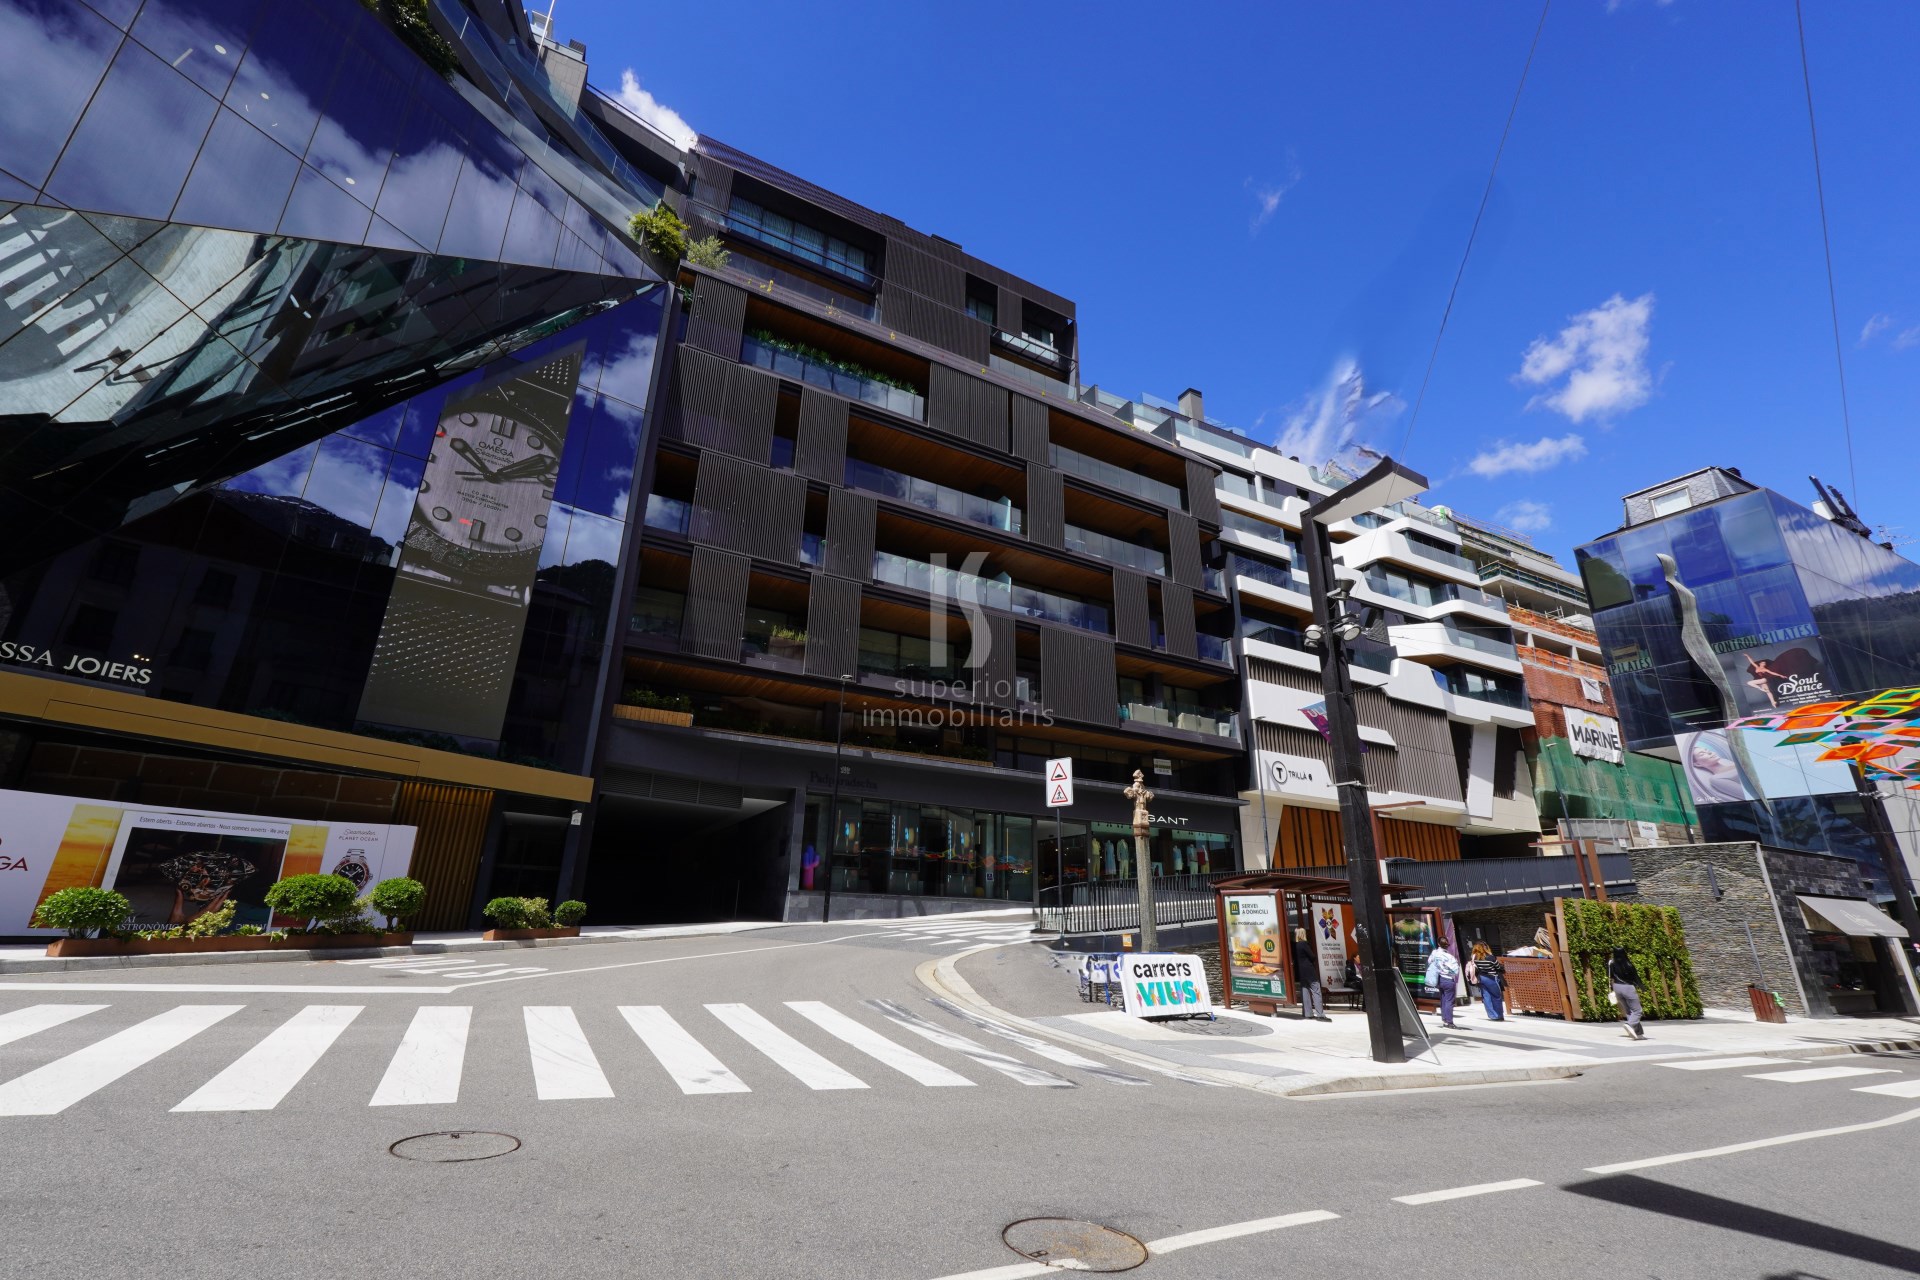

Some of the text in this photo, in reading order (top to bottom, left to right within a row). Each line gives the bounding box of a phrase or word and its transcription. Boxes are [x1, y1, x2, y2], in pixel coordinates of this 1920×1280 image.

[478, 441, 515, 458] OMEGA
[1761, 624, 1812, 645] PILATES
[0, 641, 152, 684] SSA JOIERS
[1610, 657, 1651, 676] PILATES
[1788, 672, 1819, 686] Soul
[1777, 682, 1823, 696] Dance
[1147, 814, 1189, 826] GANT
[1133, 961, 1192, 979] carrers
[1136, 980, 1198, 1007] VIUS
